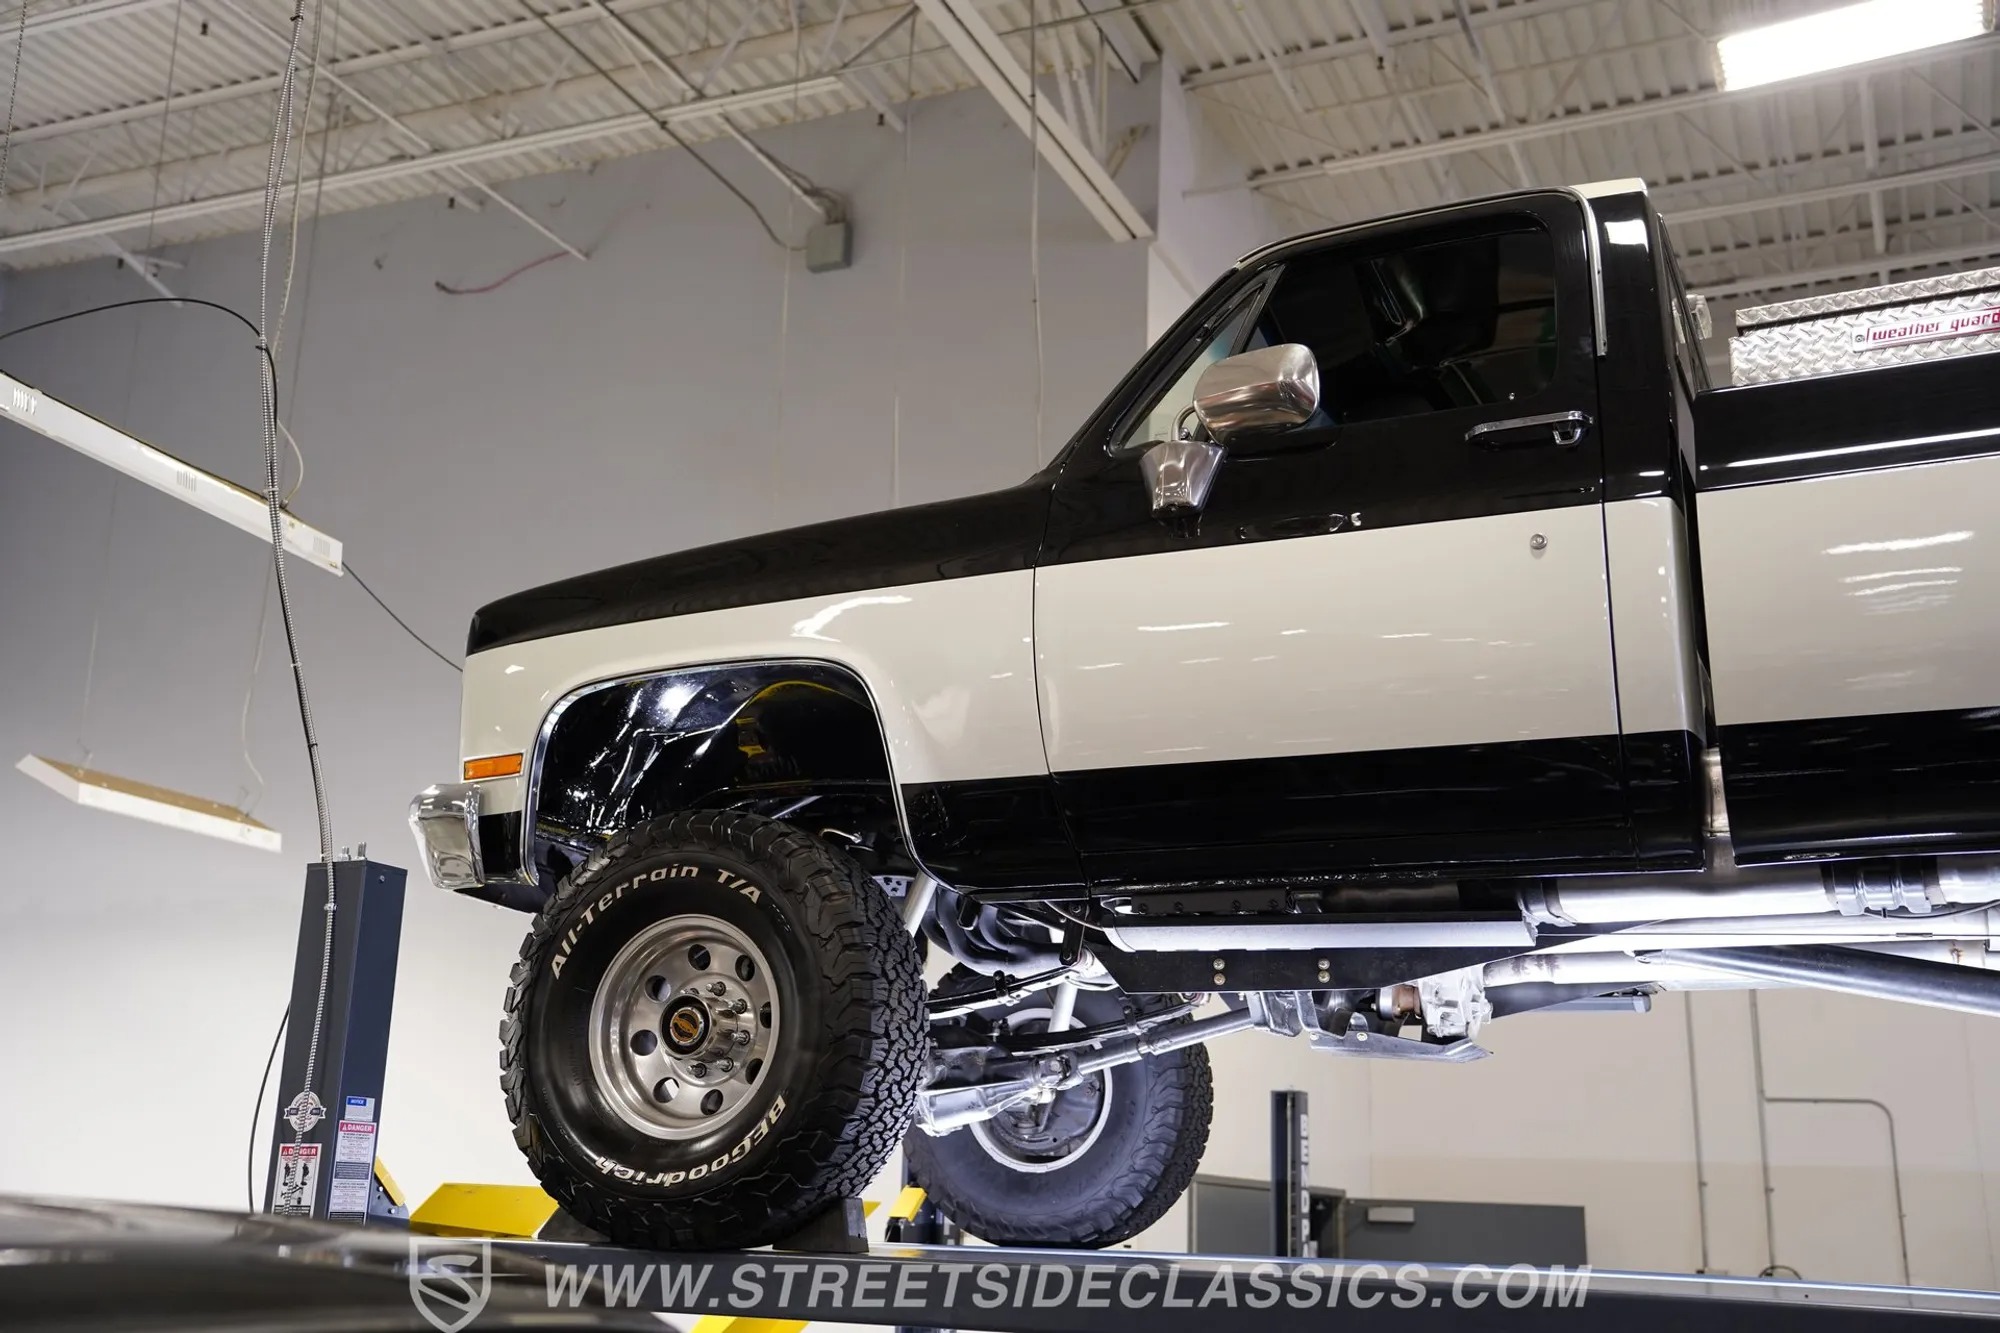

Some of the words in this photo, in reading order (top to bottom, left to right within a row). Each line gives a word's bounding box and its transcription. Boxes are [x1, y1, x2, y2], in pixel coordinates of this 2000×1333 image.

[1872, 322, 1940, 341] weather
[551, 864, 699, 980] All-Terrain
[716, 869, 762, 905] T/A
[347, 1123, 373, 1133] DANGER
[595, 1095, 787, 1188] BFGoodrich
